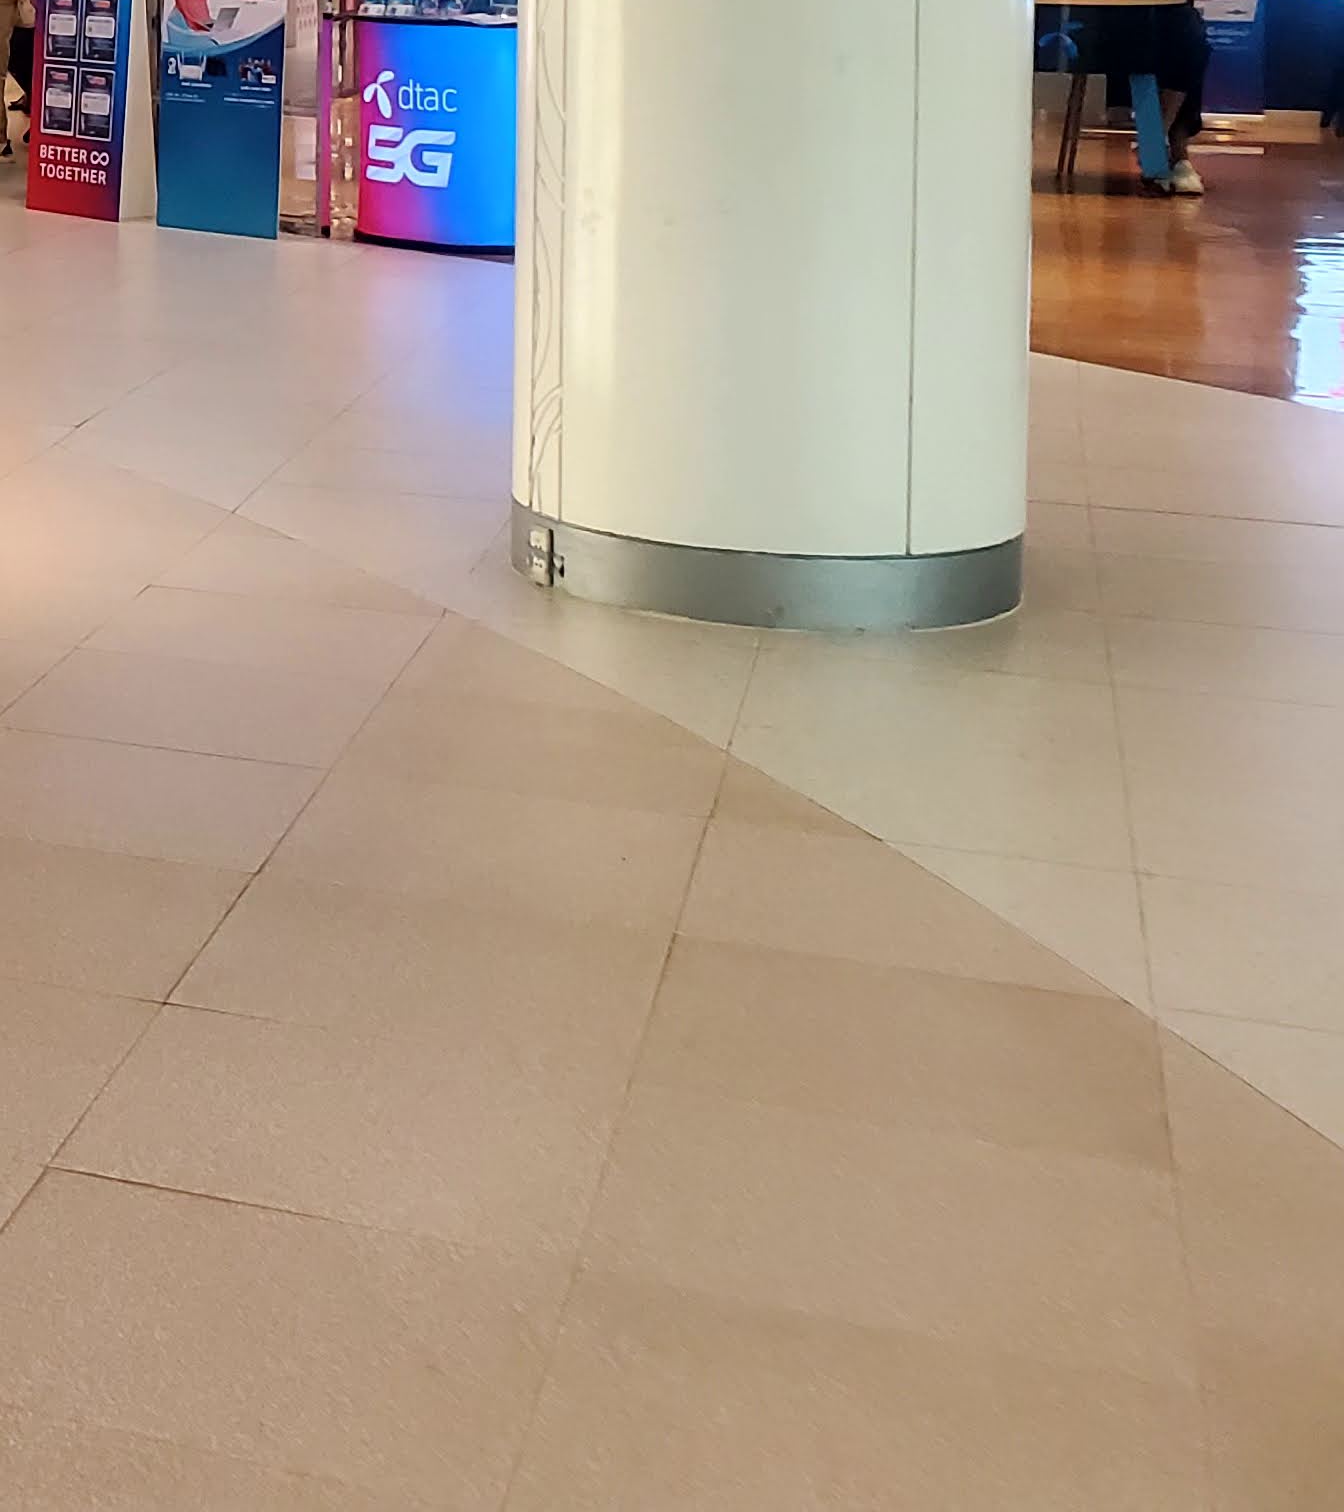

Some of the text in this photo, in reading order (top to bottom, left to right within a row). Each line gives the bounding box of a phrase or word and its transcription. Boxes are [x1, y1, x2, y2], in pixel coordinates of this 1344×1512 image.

[398, 79, 458, 113] dtac
[39, 144, 88, 165] BETTER
[365, 123, 457, 189] 5G
[39, 162, 107, 186] TOGETHER
